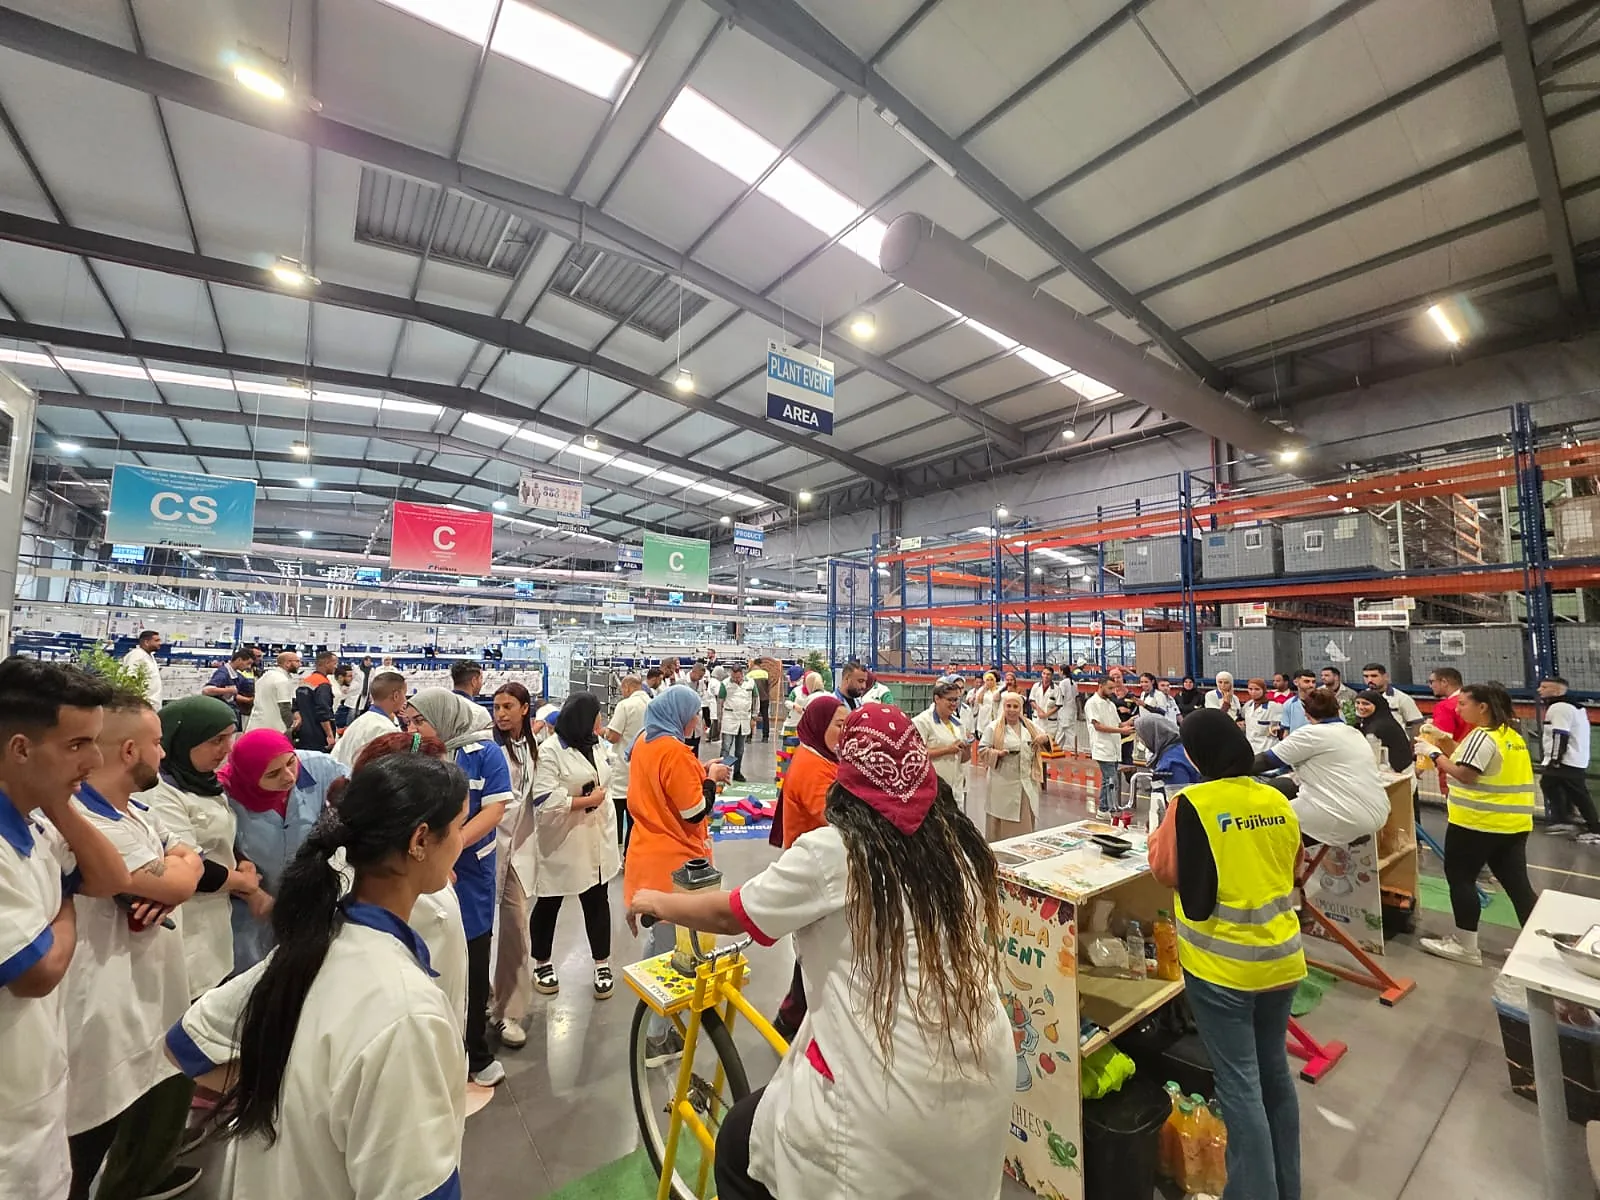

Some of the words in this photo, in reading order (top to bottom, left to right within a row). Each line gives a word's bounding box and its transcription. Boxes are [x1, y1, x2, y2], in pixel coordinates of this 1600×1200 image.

[771, 356, 802, 383] PLANT
[803, 367, 830, 393] EVENT
[782, 403, 819, 427] AREA
[151, 491, 218, 525] CS
[433, 525, 457, 551] C
[735, 530, 762, 541] PRODUCT
[668, 551, 685, 572] C
[749, 548, 761, 557] AREA
[1234, 814, 1286, 830] Fujikura
